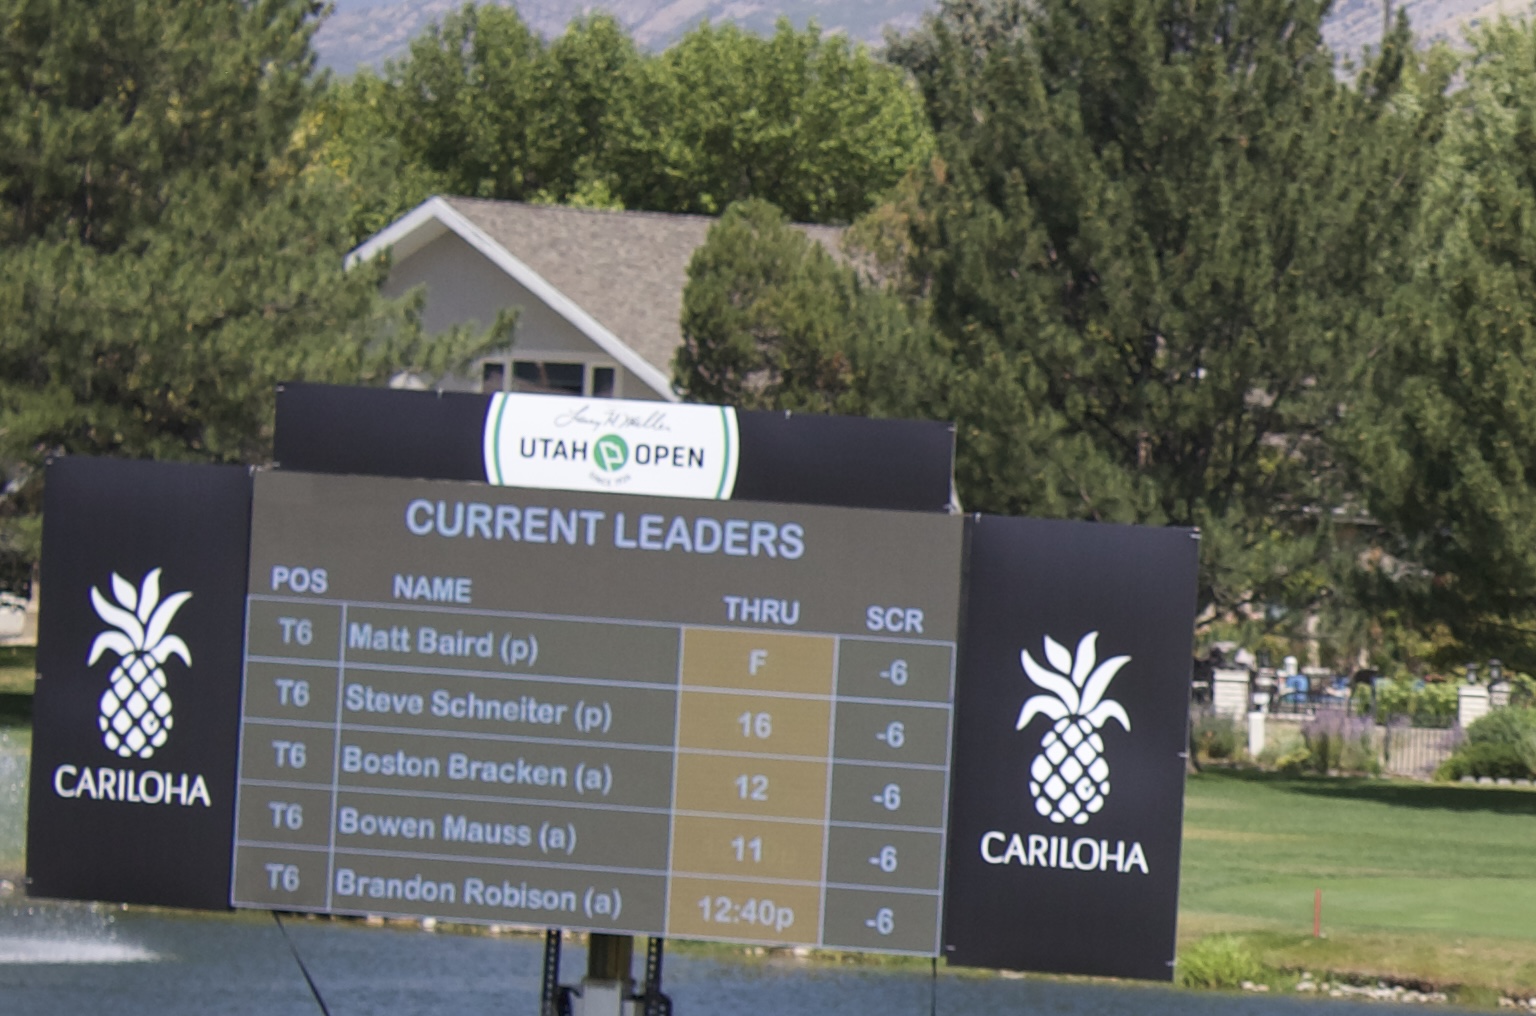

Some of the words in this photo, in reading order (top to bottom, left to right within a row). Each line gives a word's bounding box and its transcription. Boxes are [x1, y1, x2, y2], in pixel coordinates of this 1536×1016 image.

[519, 437, 588, 460] UTAH
[634, 443, 705, 469] OPEN
[406, 500, 606, 546] CURRENT
[614, 512, 805, 559] LEADERS
[271, 565, 329, 594] POS
[393, 574, 473, 603] NAME
[723, 595, 800, 625] THRU
[866, 606, 924, 633] SCR
[278, 617, 313, 646] T6
[349, 622, 411, 653] Matt
[417, 627, 494, 659] Baird
[501, 632, 539, 667] (p)
[748, 650, 769, 676] F
[879, 659, 909, 687] -6
[275, 679, 310, 708] T6
[345, 683, 424, 715] Steve
[431, 689, 567, 725] Schneiter
[574, 701, 612, 733] (p)
[737, 712, 773, 739] 16
[875, 721, 906, 749] -6
[53, 763, 211, 808] CARILOHA
[272, 740, 307, 769] T6
[343, 745, 440, 779] Boston
[448, 753, 568, 788] Bracken
[574, 762, 613, 796] (a)
[734, 774, 769, 801] 12
[872, 783, 902, 811] -6
[269, 801, 304, 830] T6
[339, 806, 435, 841] Bowen
[443, 815, 532, 848] Mauss
[538, 822, 577, 855] (a)
[731, 836, 763, 862] 11
[868, 845, 898, 873] -6
[979, 830, 1149, 875] CARILOHA
[265, 863, 301, 892] T6
[335, 868, 457, 904] Brandon
[464, 877, 577, 913] Robison
[583, 886, 623, 920] (a)
[697, 896, 795, 933] 12:40p
[865, 907, 895, 935] -6
